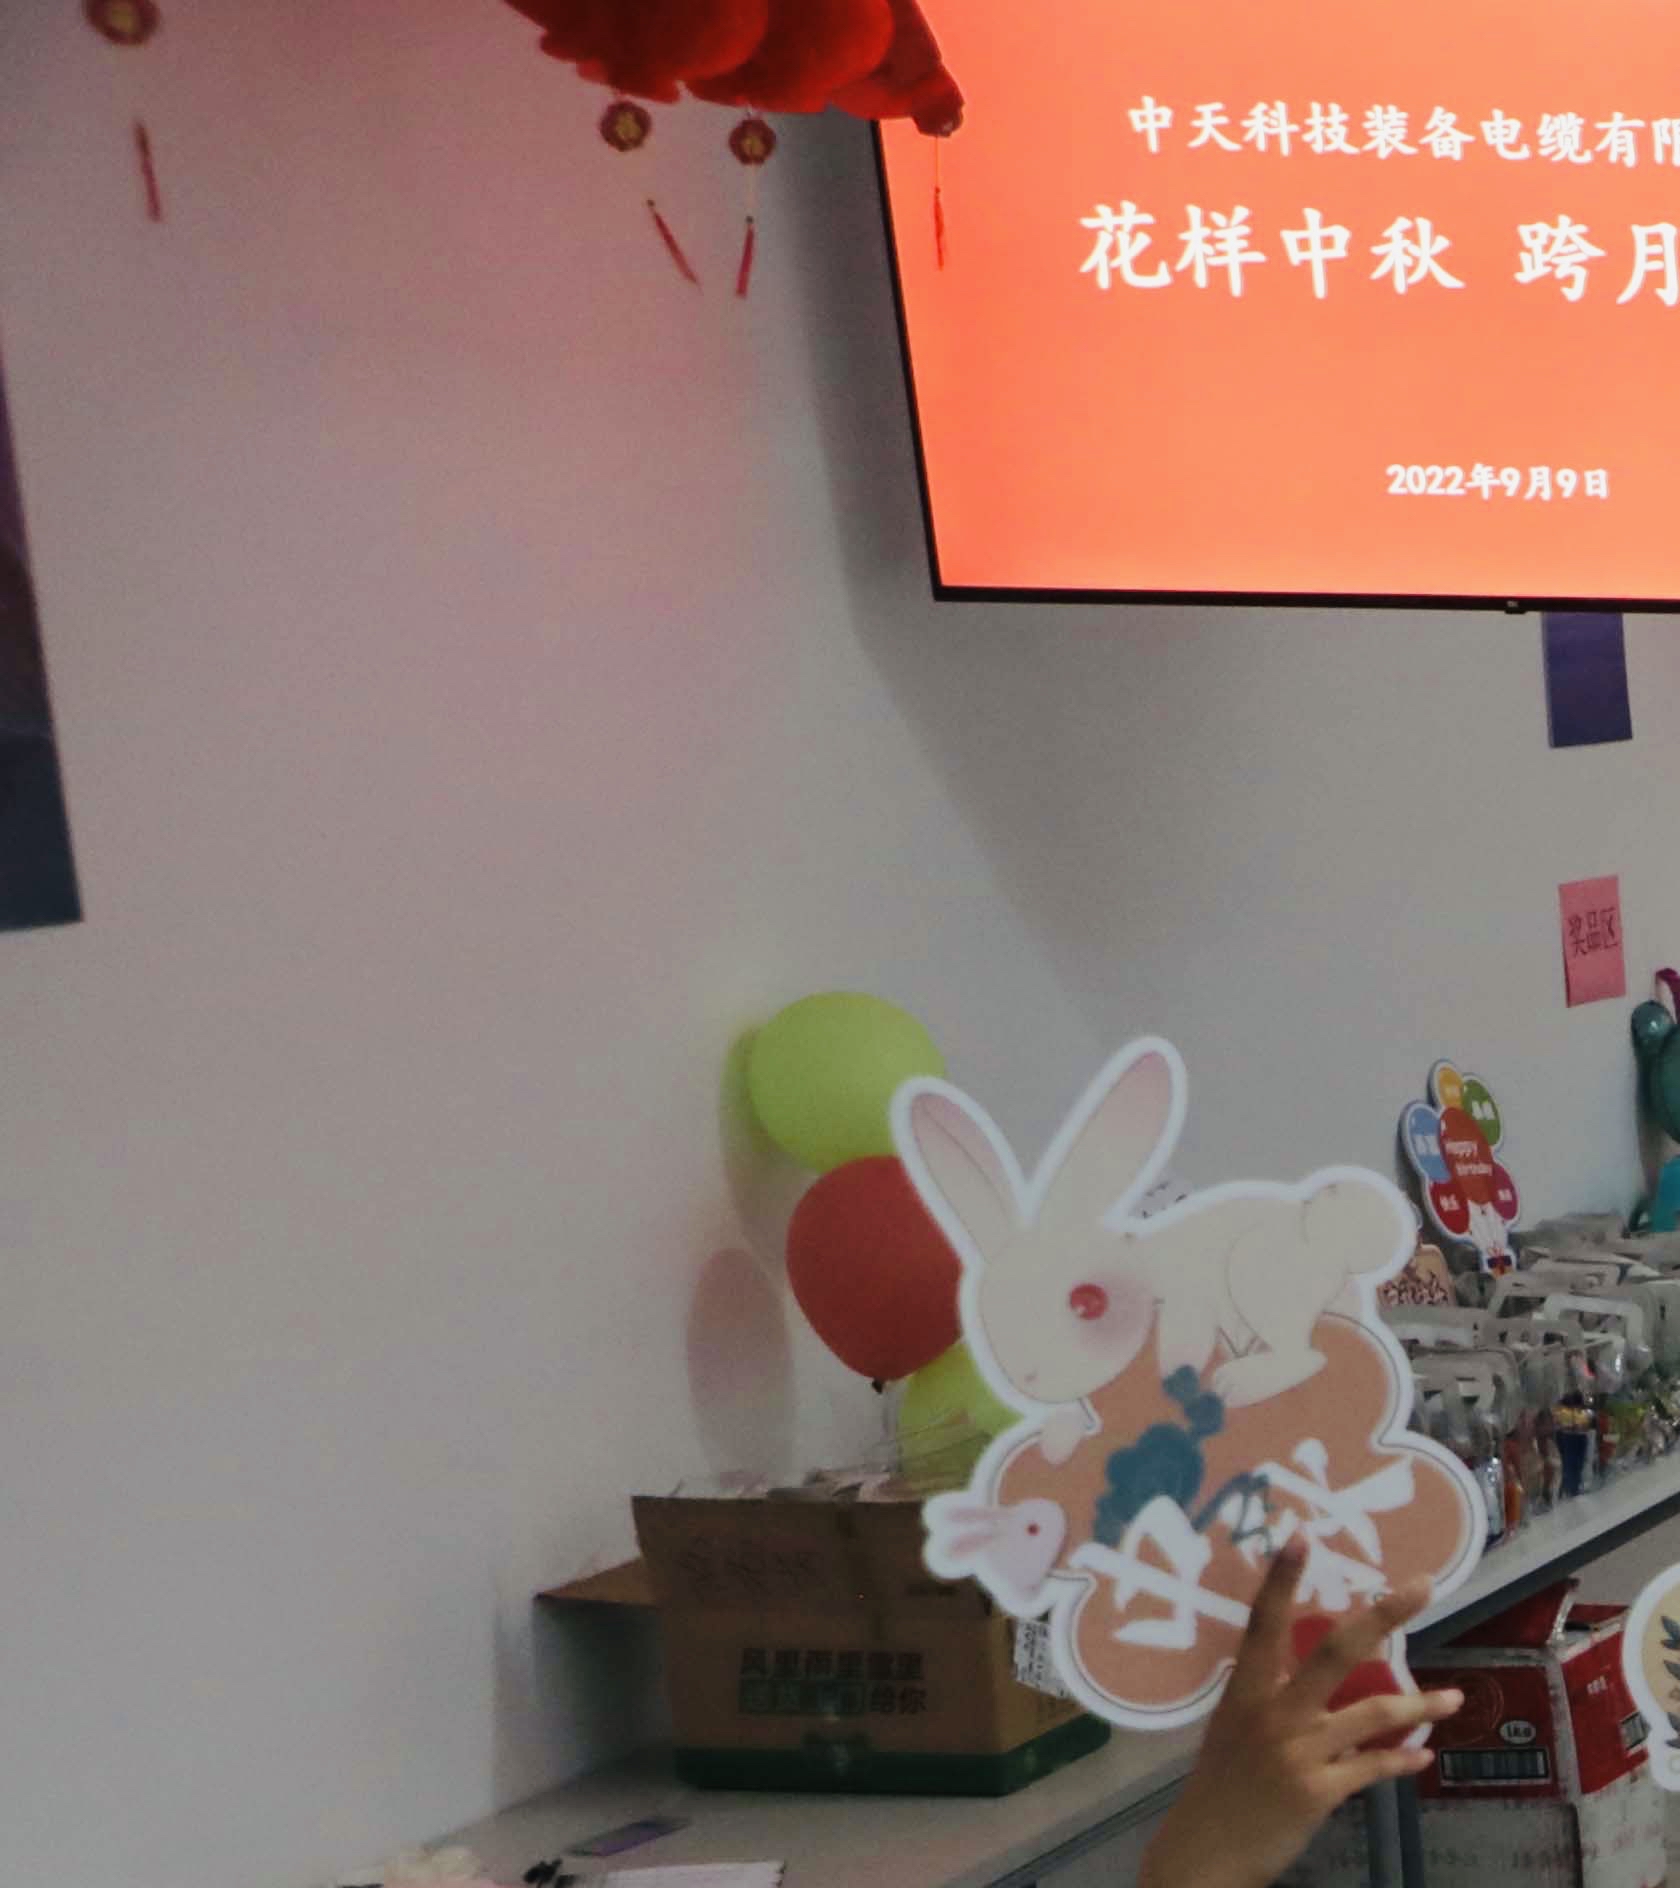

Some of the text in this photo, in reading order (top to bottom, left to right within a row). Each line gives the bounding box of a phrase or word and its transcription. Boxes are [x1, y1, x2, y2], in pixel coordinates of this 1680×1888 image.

[1078, 200, 1466, 300] 花样中秋
[1385, 459, 1612, 502] 2022年9月9日
